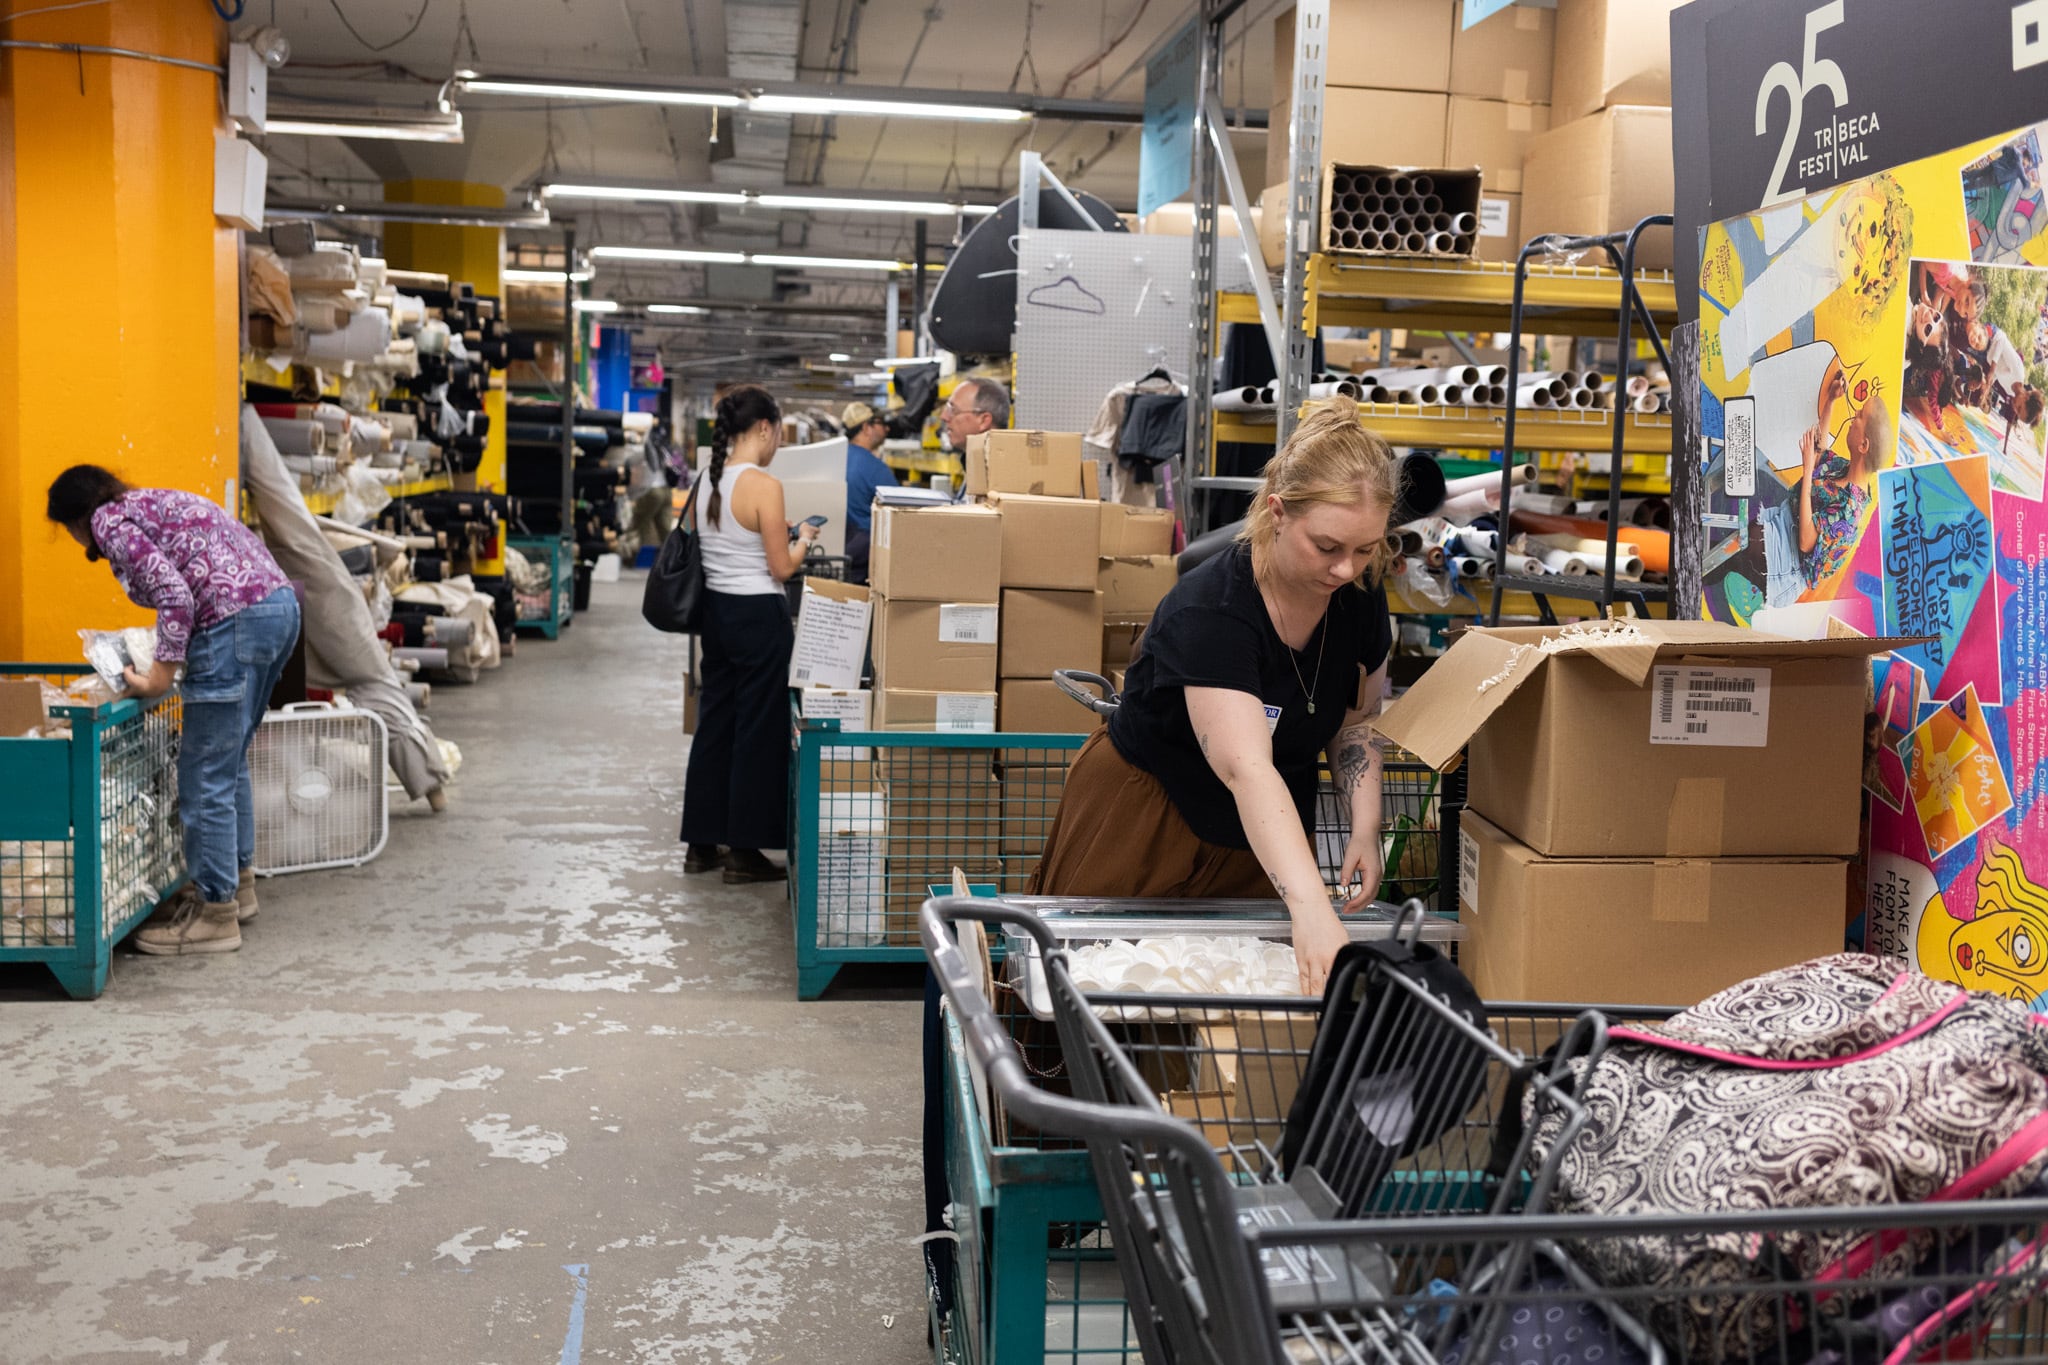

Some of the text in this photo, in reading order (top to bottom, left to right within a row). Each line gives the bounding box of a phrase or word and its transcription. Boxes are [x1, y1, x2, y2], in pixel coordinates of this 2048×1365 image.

[1755, 0, 1849, 209] 25
[1814, 112, 1880, 150] TRIBECA
[1799, 142, 1869, 180] FESTIVAL
[2016, 511, 2024, 557] Corner
[2038, 533, 2047, 587] Loisaida
[1908, 517, 1922, 637] WELCOMES
[2016, 559, 2024, 573] of
[2016, 577, 2025, 602] 2nd
[1926, 577, 1944, 667] LIBERTY
[1935, 570, 1953, 630] LADY
[2038, 590, 2047, 635] Center
[2016, 605, 2025, 652] Avenue
[2016, 670, 2025, 723] Houston
[2026, 553, 2036, 805] Community Mural at First Street Green
[2039, 653, 2047, 708] FABNYC
[2038, 725, 2047, 764] Thrive
[2016, 775, 2024, 844] Manhattan
[1872, 882, 1884, 953] HEART
[1885, 870, 1896, 921] FROM
[1898, 878, 1910, 936] MAKE
